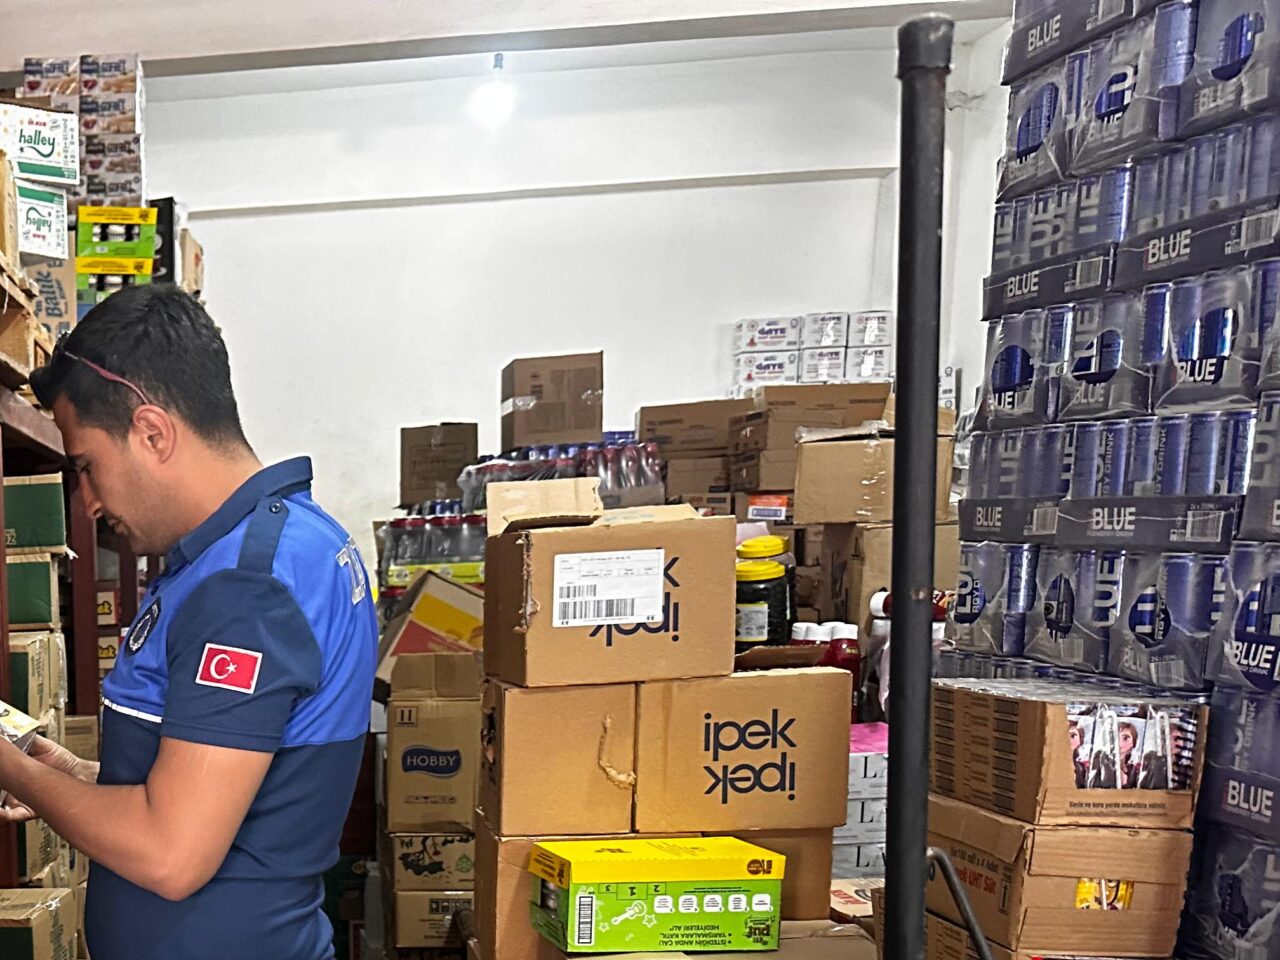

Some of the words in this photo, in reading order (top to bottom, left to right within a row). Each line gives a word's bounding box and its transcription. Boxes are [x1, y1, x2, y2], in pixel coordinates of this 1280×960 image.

[1027, 15, 1061, 51] BLUE
[19, 129, 55, 158] halley
[1147, 229, 1192, 264] BLUE
[1006, 270, 1040, 298] BLUE
[976, 506, 1002, 526] BLUE
[1093, 507, 1136, 530] BLUE
[1232, 641, 1275, 668] BLUE
[703, 708, 796, 761] ipek
[407, 755, 457, 767] HOBBY
[703, 752, 796, 804] ipek
[1227, 780, 1274, 816] BLUE
[628, 886, 637, 897] 1
[654, 884, 661, 892] 2
